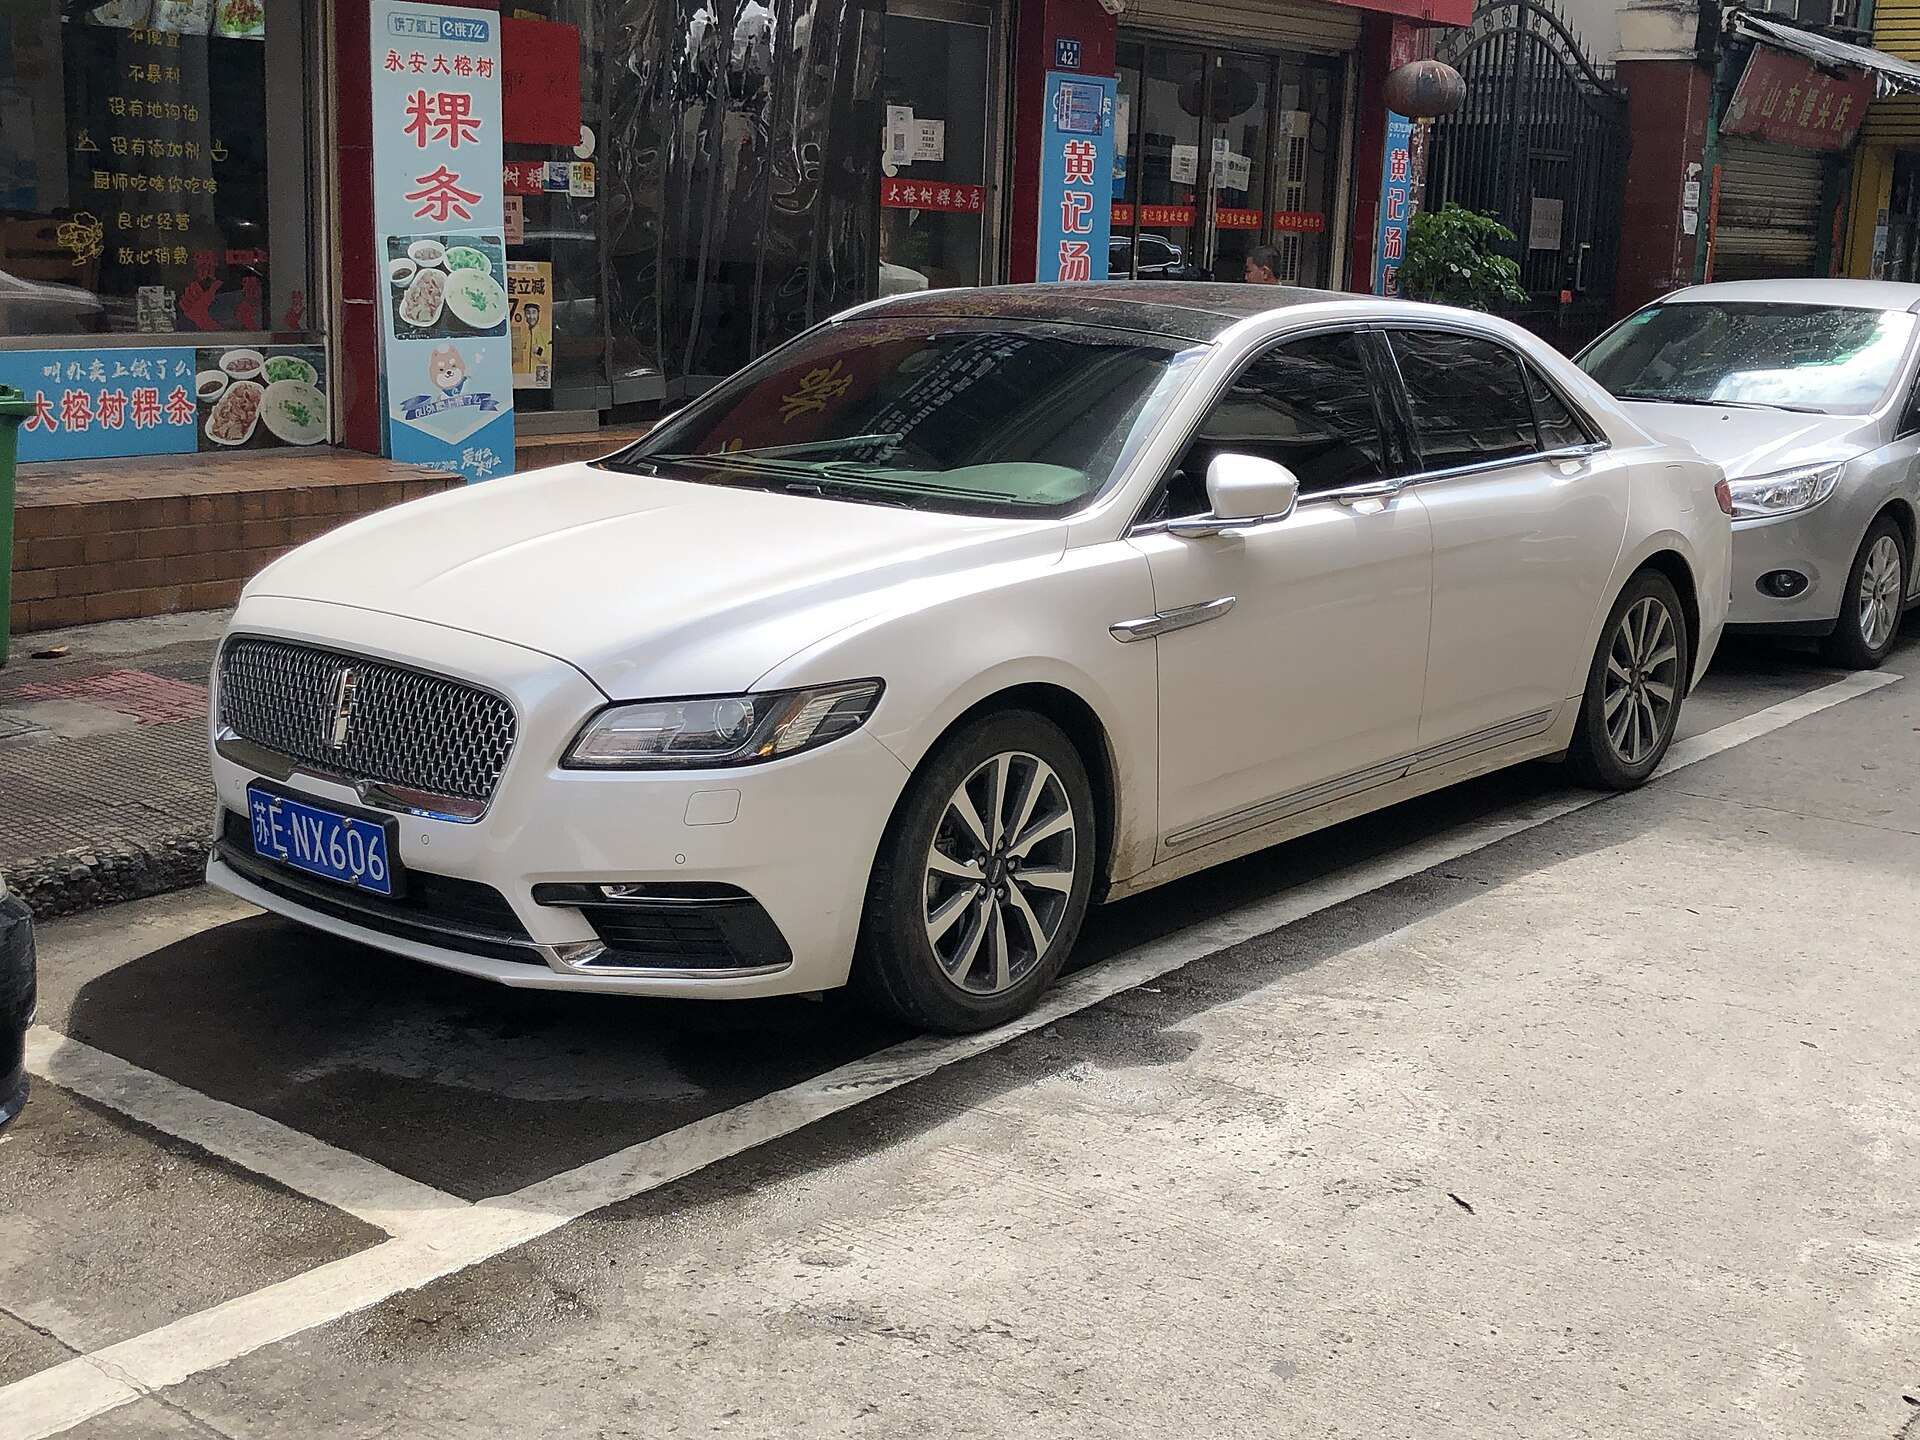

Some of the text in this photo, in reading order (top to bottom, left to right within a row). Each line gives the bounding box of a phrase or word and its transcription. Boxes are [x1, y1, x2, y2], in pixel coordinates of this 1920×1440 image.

[384, 49, 495, 79] 永安大榕树
[1061, 51, 1073, 65] 42
[128, 63, 180, 85] 不暴利
[108, 96, 199, 122] 没有地沟油
[111, 136, 200, 160] 没有添加剂
[403, 89, 483, 223] 粿条
[92, 170, 218, 194] 厨师吃啥你吃啥
[888, 184, 980, 209] 大榕树粿条店
[118, 211, 191, 231] 良心经营
[118, 245, 189, 265] 放心消费
[43, 358, 192, 384] 叫外卖上饿了么
[25, 384, 197, 433] 大榕树粿条
[254, 800, 385, 881] 苏E·NX606
